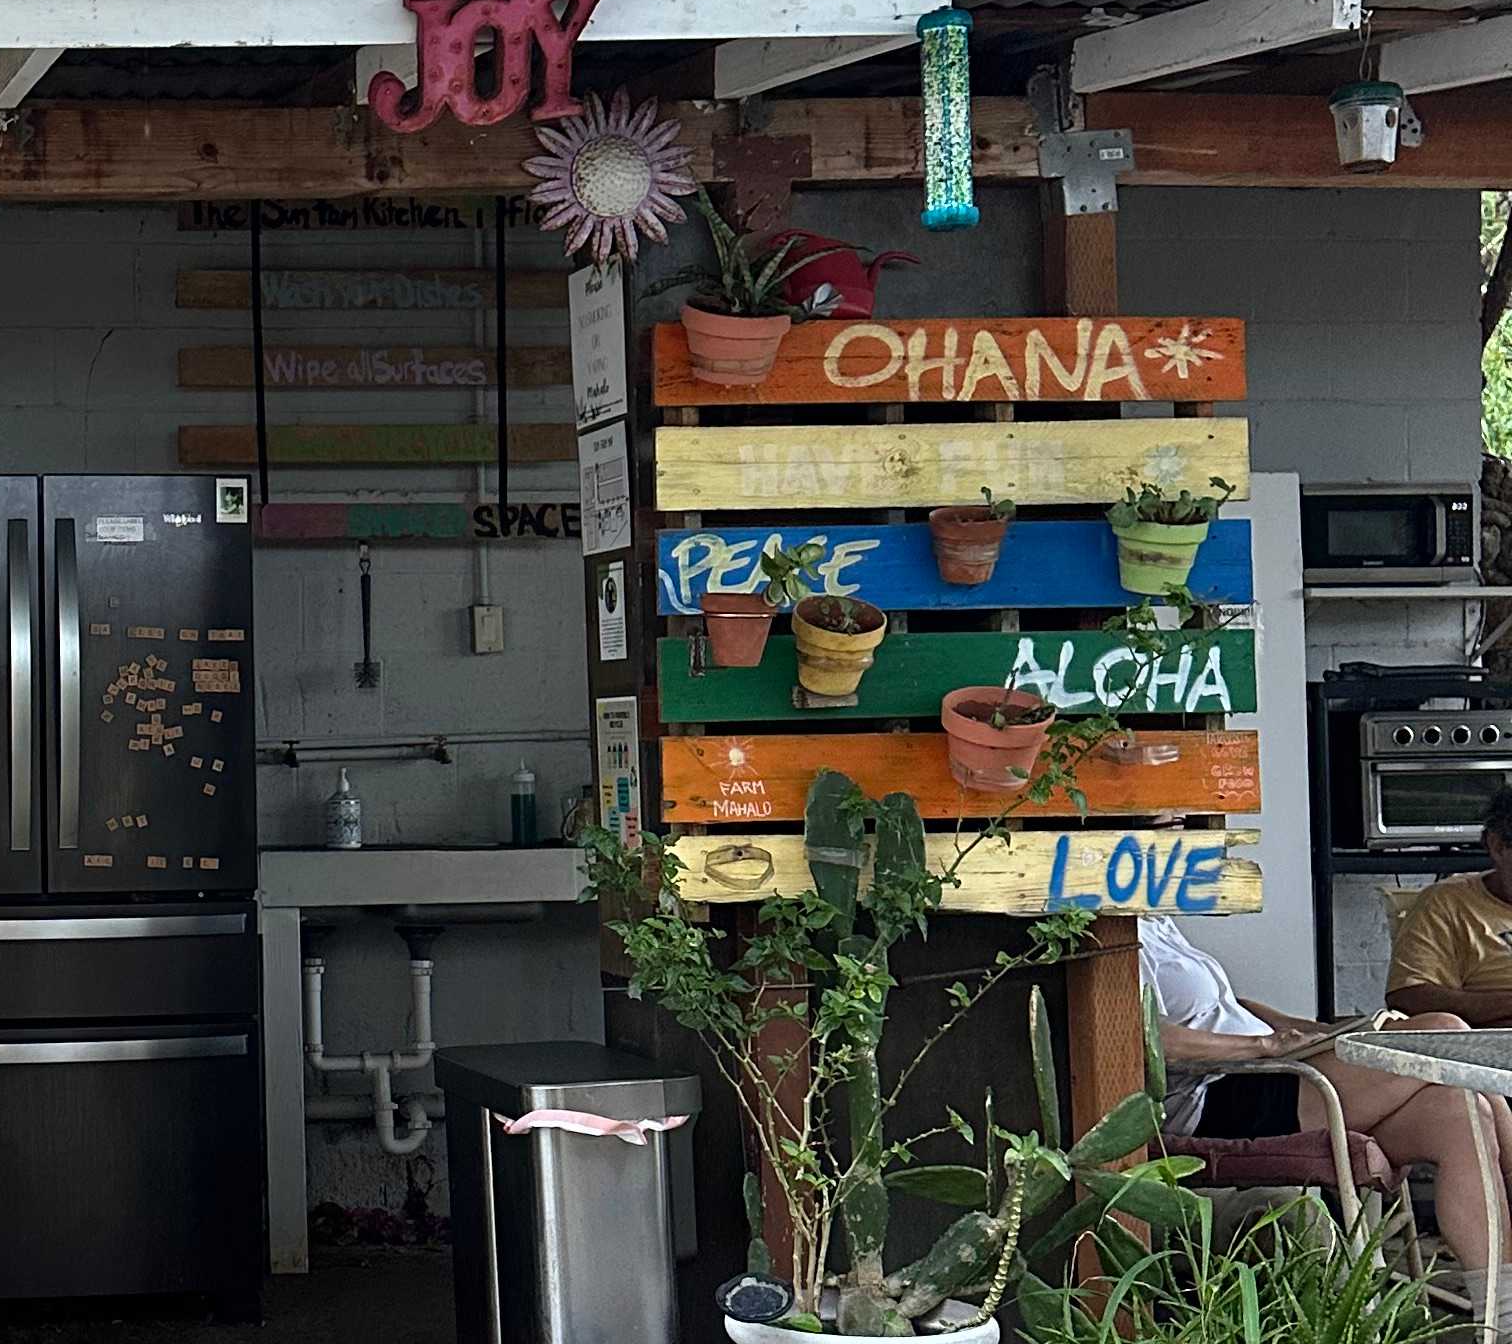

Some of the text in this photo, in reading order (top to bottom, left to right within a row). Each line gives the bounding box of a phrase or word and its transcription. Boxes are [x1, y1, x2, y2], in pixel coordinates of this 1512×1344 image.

[264, 350, 338, 384] Wipe
[823, 318, 1148, 401] OHANA
[473, 503, 582, 537] SPACE
[672, 533, 880, 607] PEAE
[1004, 637, 1232, 713] ALOHA
[713, 799, 772, 817] MAHALO
[719, 780, 765, 796] FARM
[1047, 835, 1226, 912] LOVE
